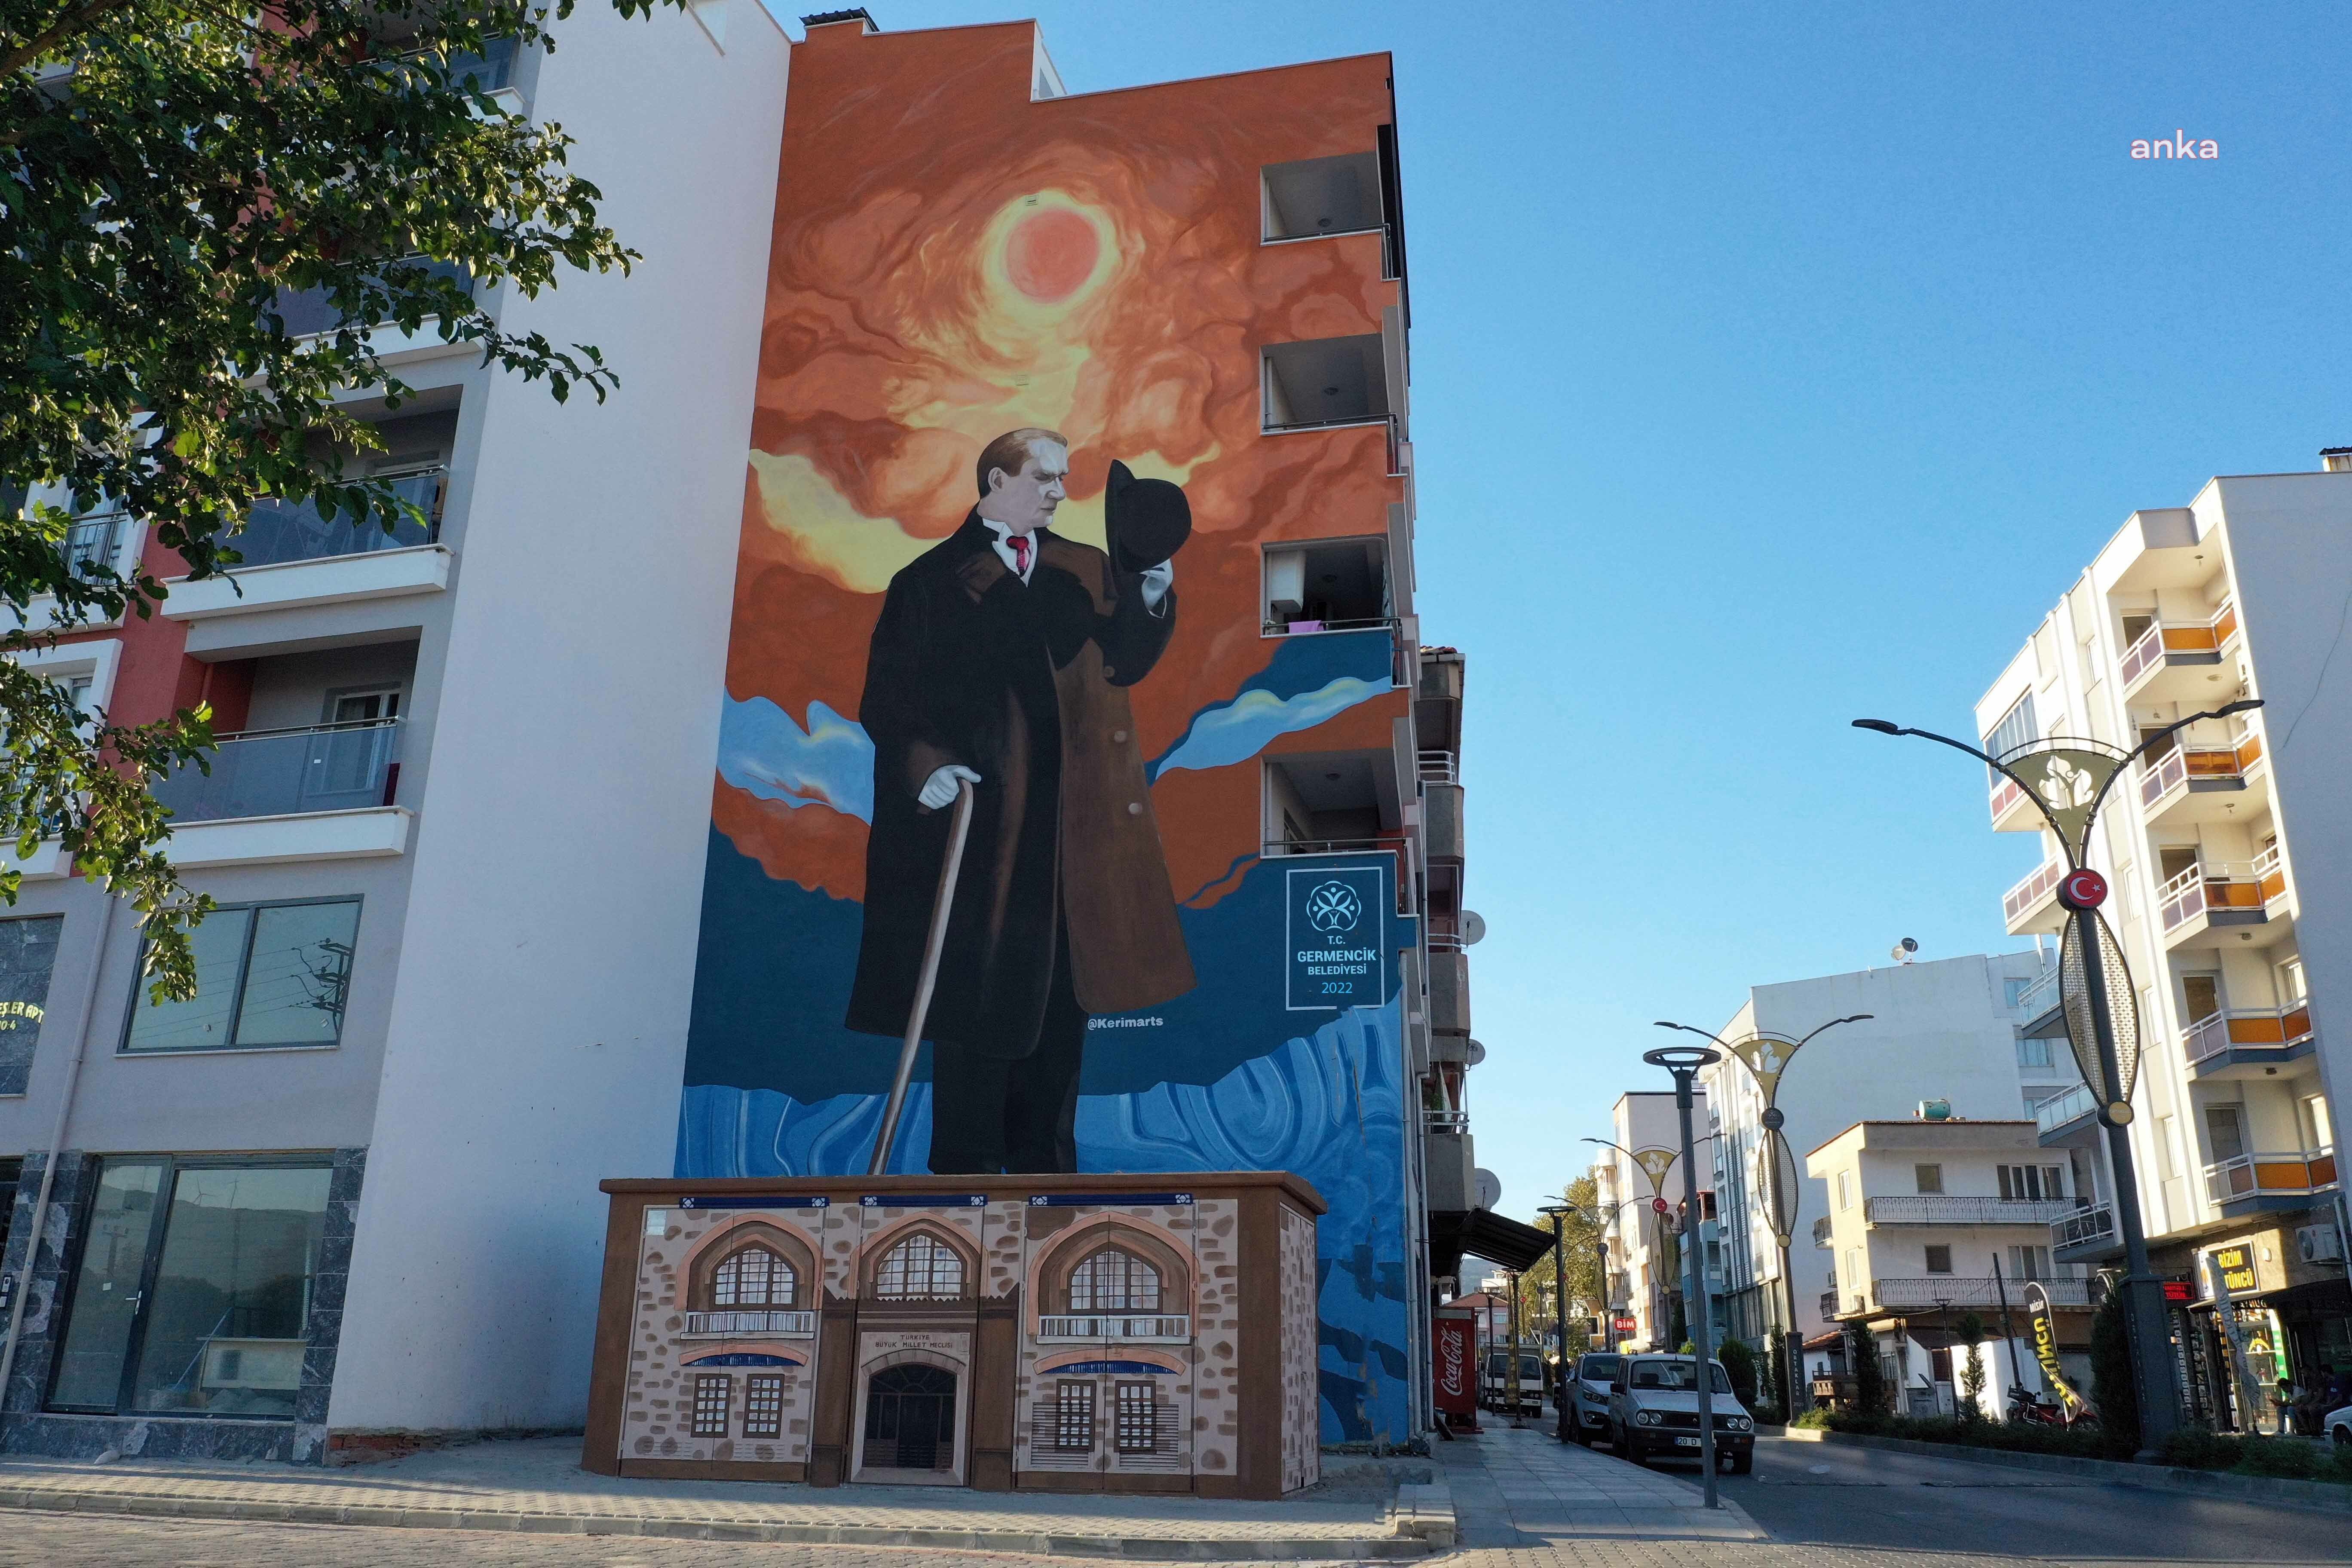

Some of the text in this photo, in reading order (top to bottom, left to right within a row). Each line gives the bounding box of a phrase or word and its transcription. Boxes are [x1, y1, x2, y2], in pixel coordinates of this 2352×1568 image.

[1327, 936, 1346, 945] T.C.
[1298, 947, 1376, 962] GERMENCİK
[1308, 963, 1367, 975] BELEDİYESİ
[1321, 982, 1353, 994] 2022
[25, 1004, 44, 1023] APT
[0, 1020, 16, 1030] O:4
[1087, 1017, 1164, 1030] @Kerimarts
[2218, 1249, 2243, 1268] BİZİM
[2224, 1268, 2254, 1289] TÜNCÜ
[1617, 1319, 1635, 1328] BİM
